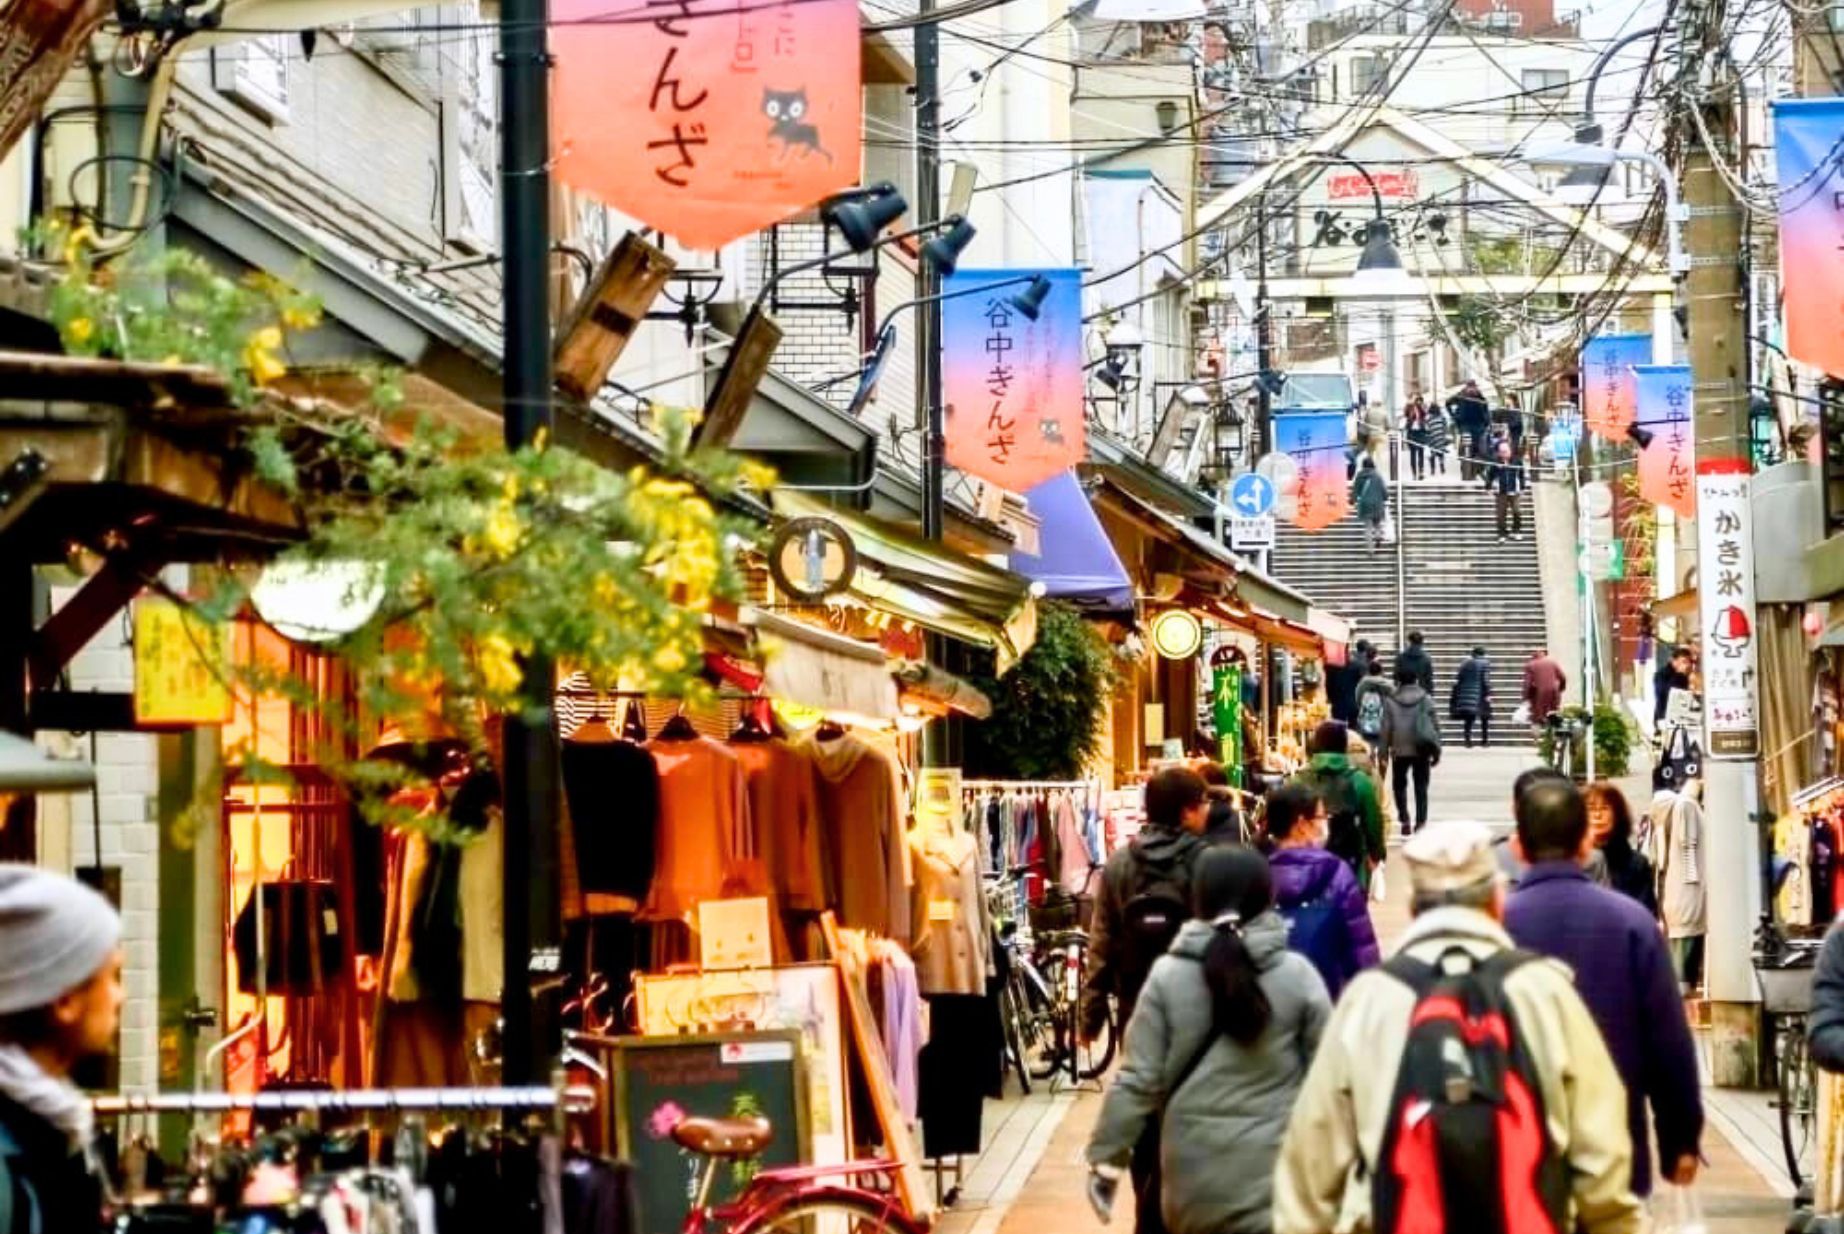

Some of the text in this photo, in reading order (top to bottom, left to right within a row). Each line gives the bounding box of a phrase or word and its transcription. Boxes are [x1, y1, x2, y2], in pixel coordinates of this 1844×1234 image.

[984, 297, 1016, 465] 谷中ぎんざ
[1666, 385, 1688, 499] 谷中ぎんざ
[1715, 509, 1743, 597] かき氷
